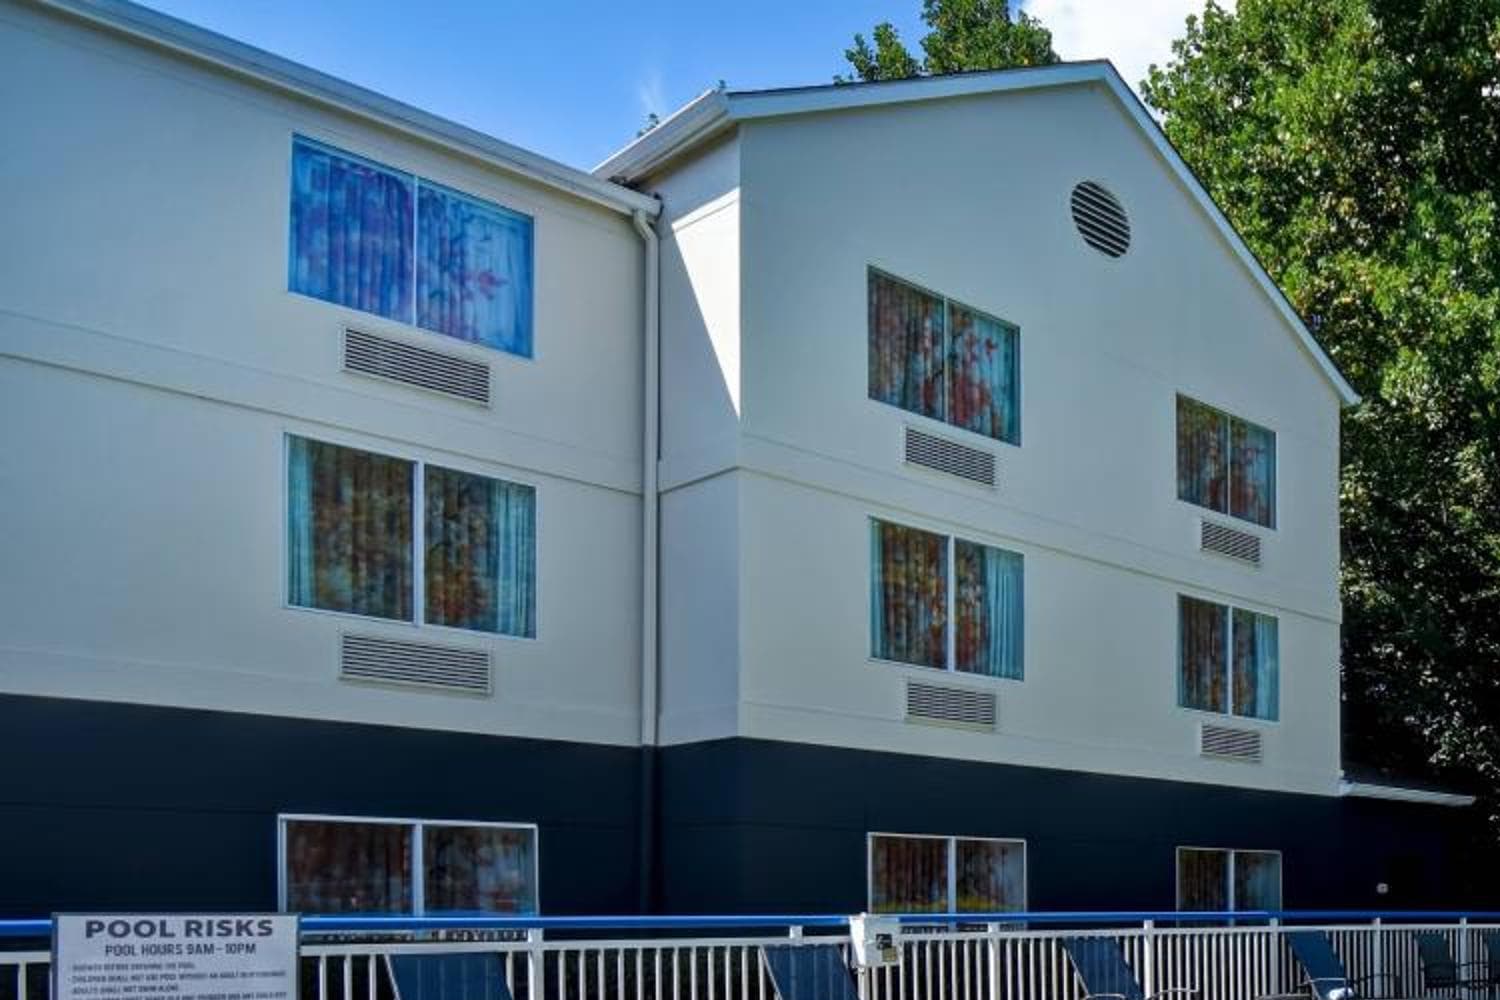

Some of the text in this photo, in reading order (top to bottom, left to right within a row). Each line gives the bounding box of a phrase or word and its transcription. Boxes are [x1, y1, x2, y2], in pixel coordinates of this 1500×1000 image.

[86, 919, 273, 938] POOL RISKS
[105, 944, 138, 957] POOL
[141, 943, 183, 956] HOURS
